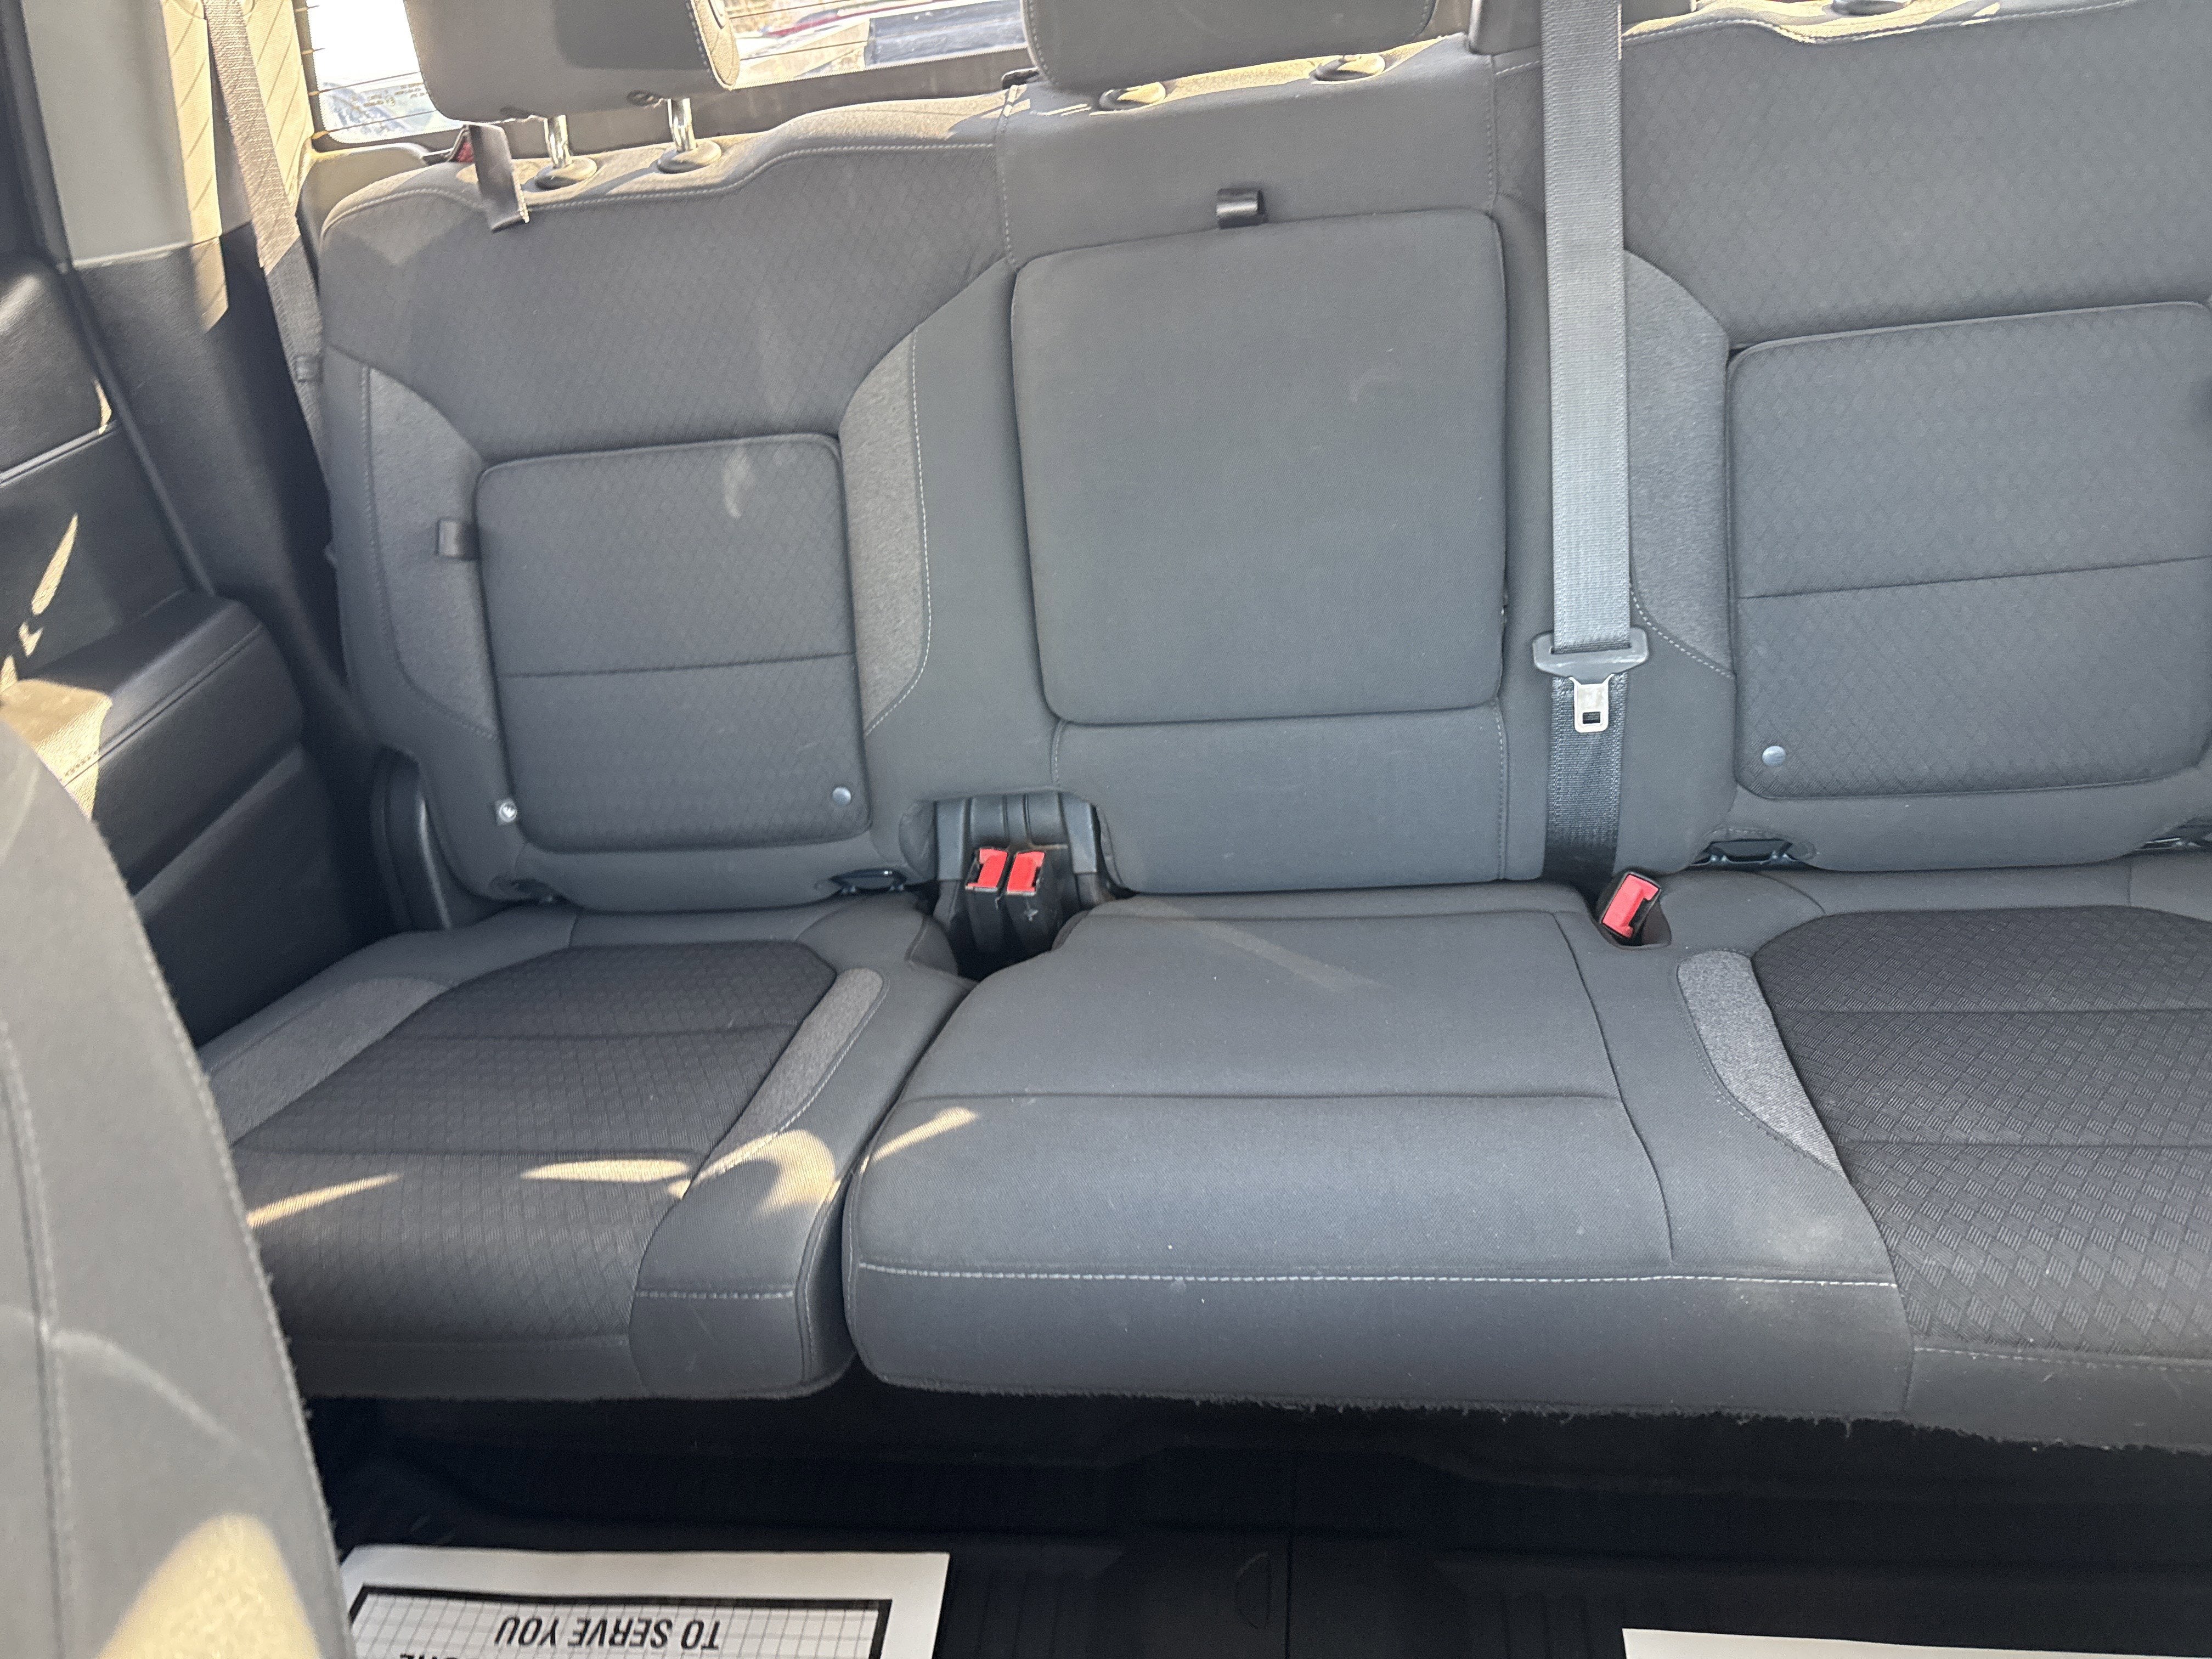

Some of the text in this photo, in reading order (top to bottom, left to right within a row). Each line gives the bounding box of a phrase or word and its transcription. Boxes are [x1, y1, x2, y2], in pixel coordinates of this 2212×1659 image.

[494, 1617, 721, 1650] TO SERVE YOU
